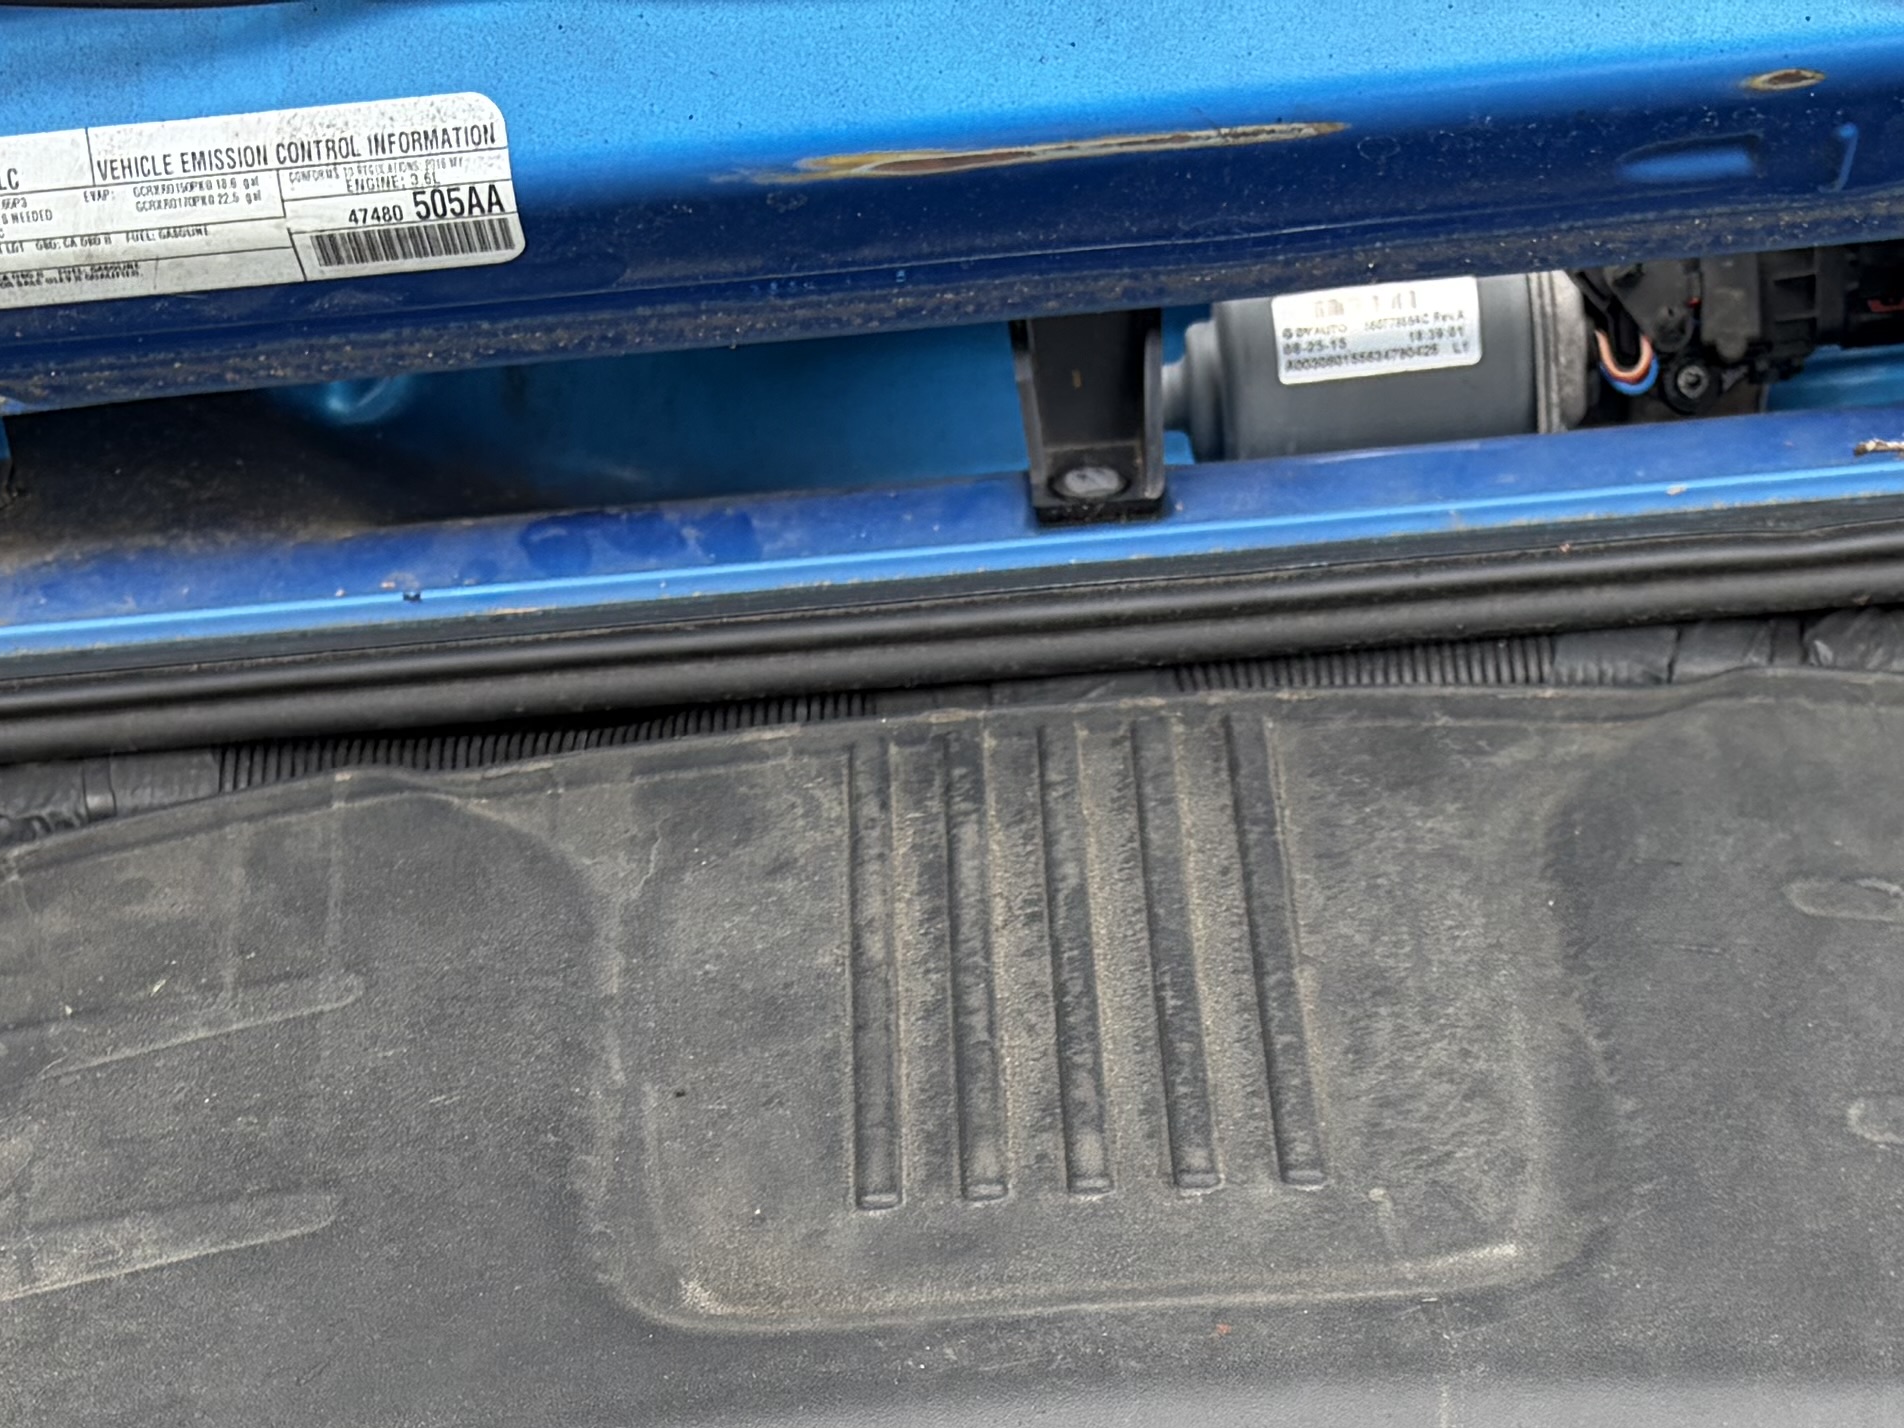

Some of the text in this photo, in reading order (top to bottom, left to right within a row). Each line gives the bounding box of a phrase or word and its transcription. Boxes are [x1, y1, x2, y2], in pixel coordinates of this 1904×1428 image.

[97, 122, 496, 181] VEHICLE EMISSION CONTROL INFORMATION
[346, 172, 440, 193] ENGINE: 3.6L
[348, 184, 505, 224] 47480 505AA
